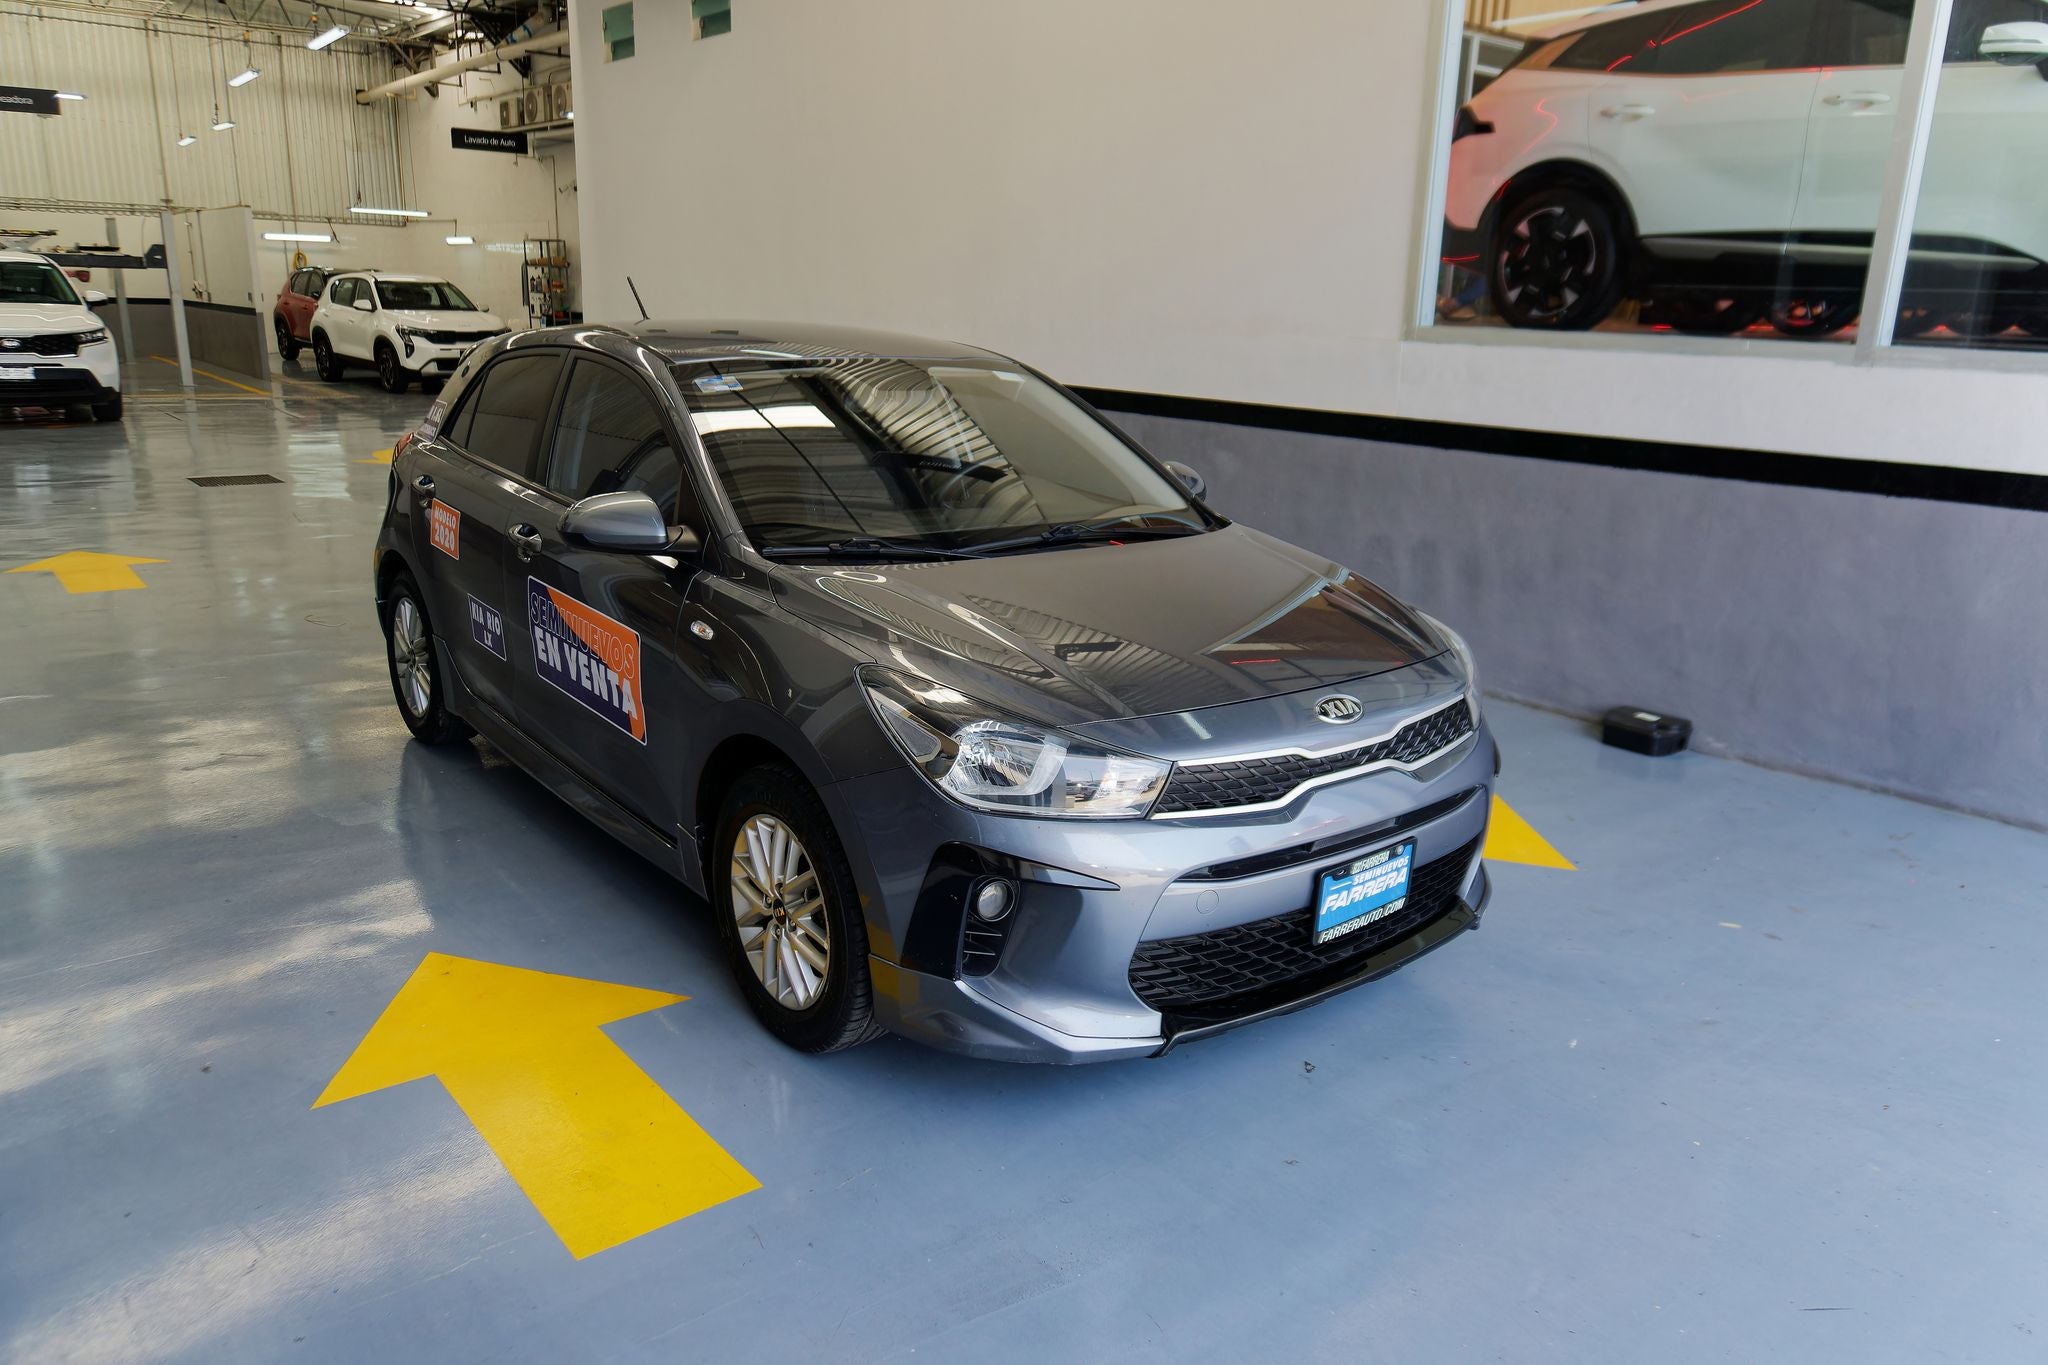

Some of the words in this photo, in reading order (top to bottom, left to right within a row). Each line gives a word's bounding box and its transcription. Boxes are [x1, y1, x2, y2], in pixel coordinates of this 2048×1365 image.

[464, 134, 489, 145] Lavado
[490, 137, 499, 146] de
[500, 138, 516, 147] Auto
[434, 505, 457, 528] MODELO
[434, 523, 455, 552] 2020
[471, 601, 484, 625] KIA
[486, 612, 500, 636] RIO
[483, 631, 493, 648] LX
[530, 592, 635, 679] SEMINUEVOS
[534, 625, 562, 673] EN
[563, 642, 638, 720] VENTA
[1322, 699, 1361, 718] KIA
[1352, 855, 1409, 886] SEMINUEVOS
[1321, 867, 1407, 915] FARRERA
[1319, 897, 1406, 944] FARRERAUTO.COM
